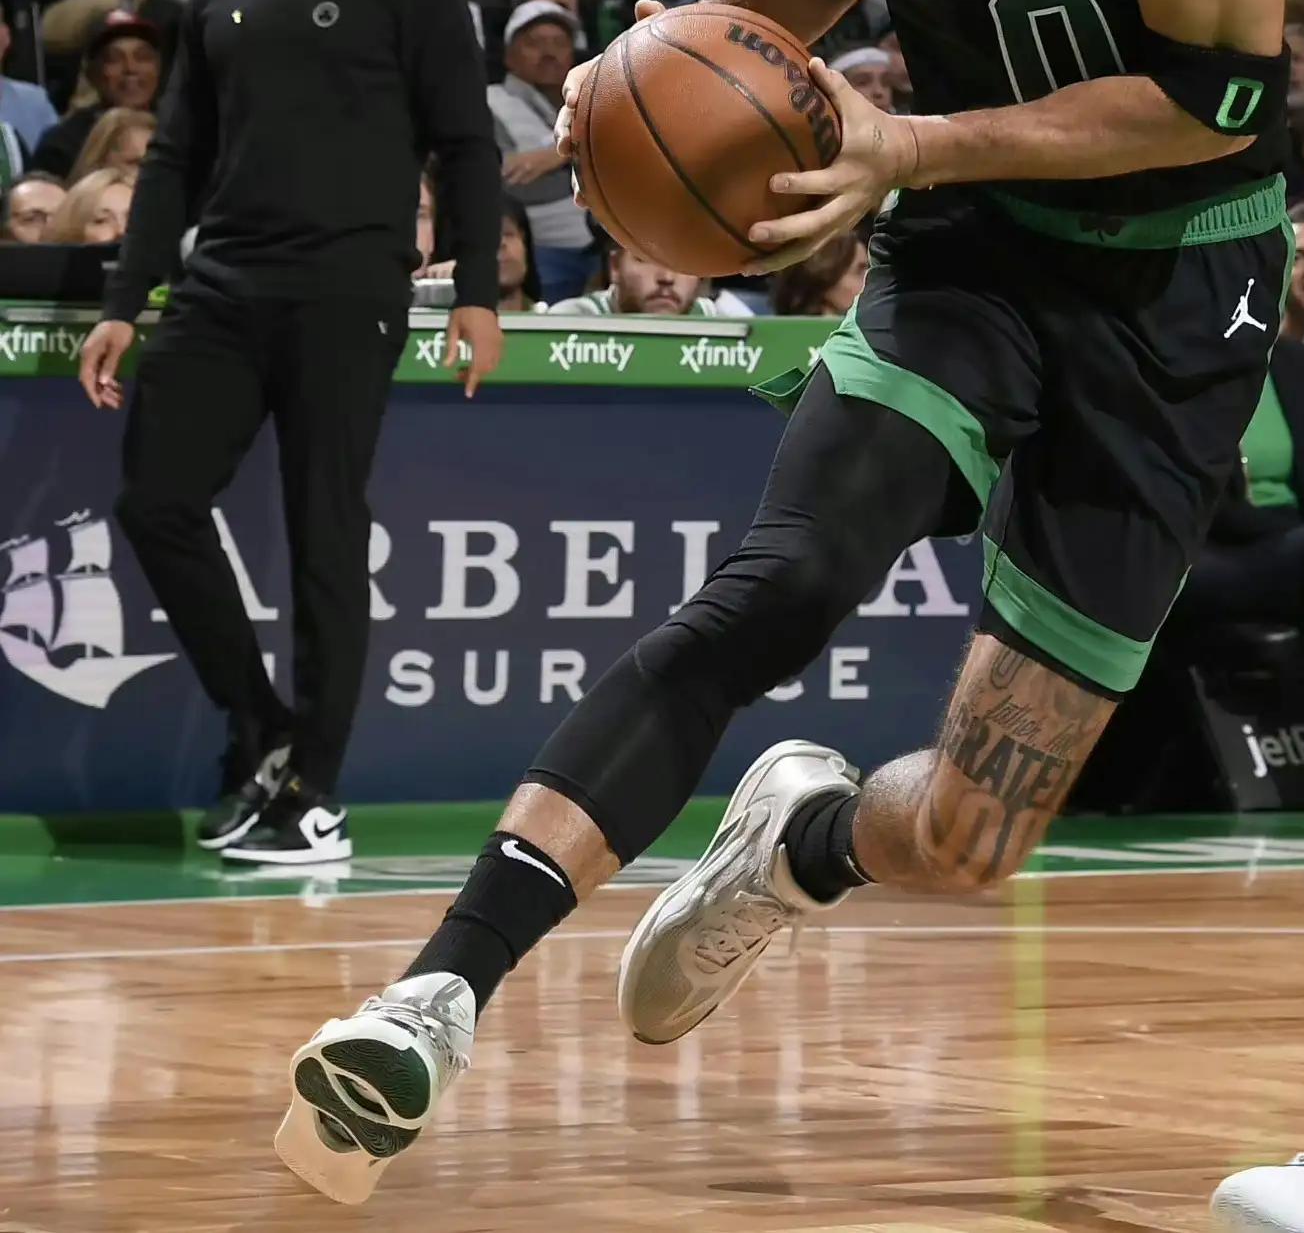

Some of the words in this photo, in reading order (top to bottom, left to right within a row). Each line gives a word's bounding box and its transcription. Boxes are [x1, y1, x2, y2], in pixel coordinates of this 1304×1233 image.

[1216, 77, 1264, 128] 0
[549, 334, 634, 371] xfinity
[680, 337, 762, 373] xfinity
